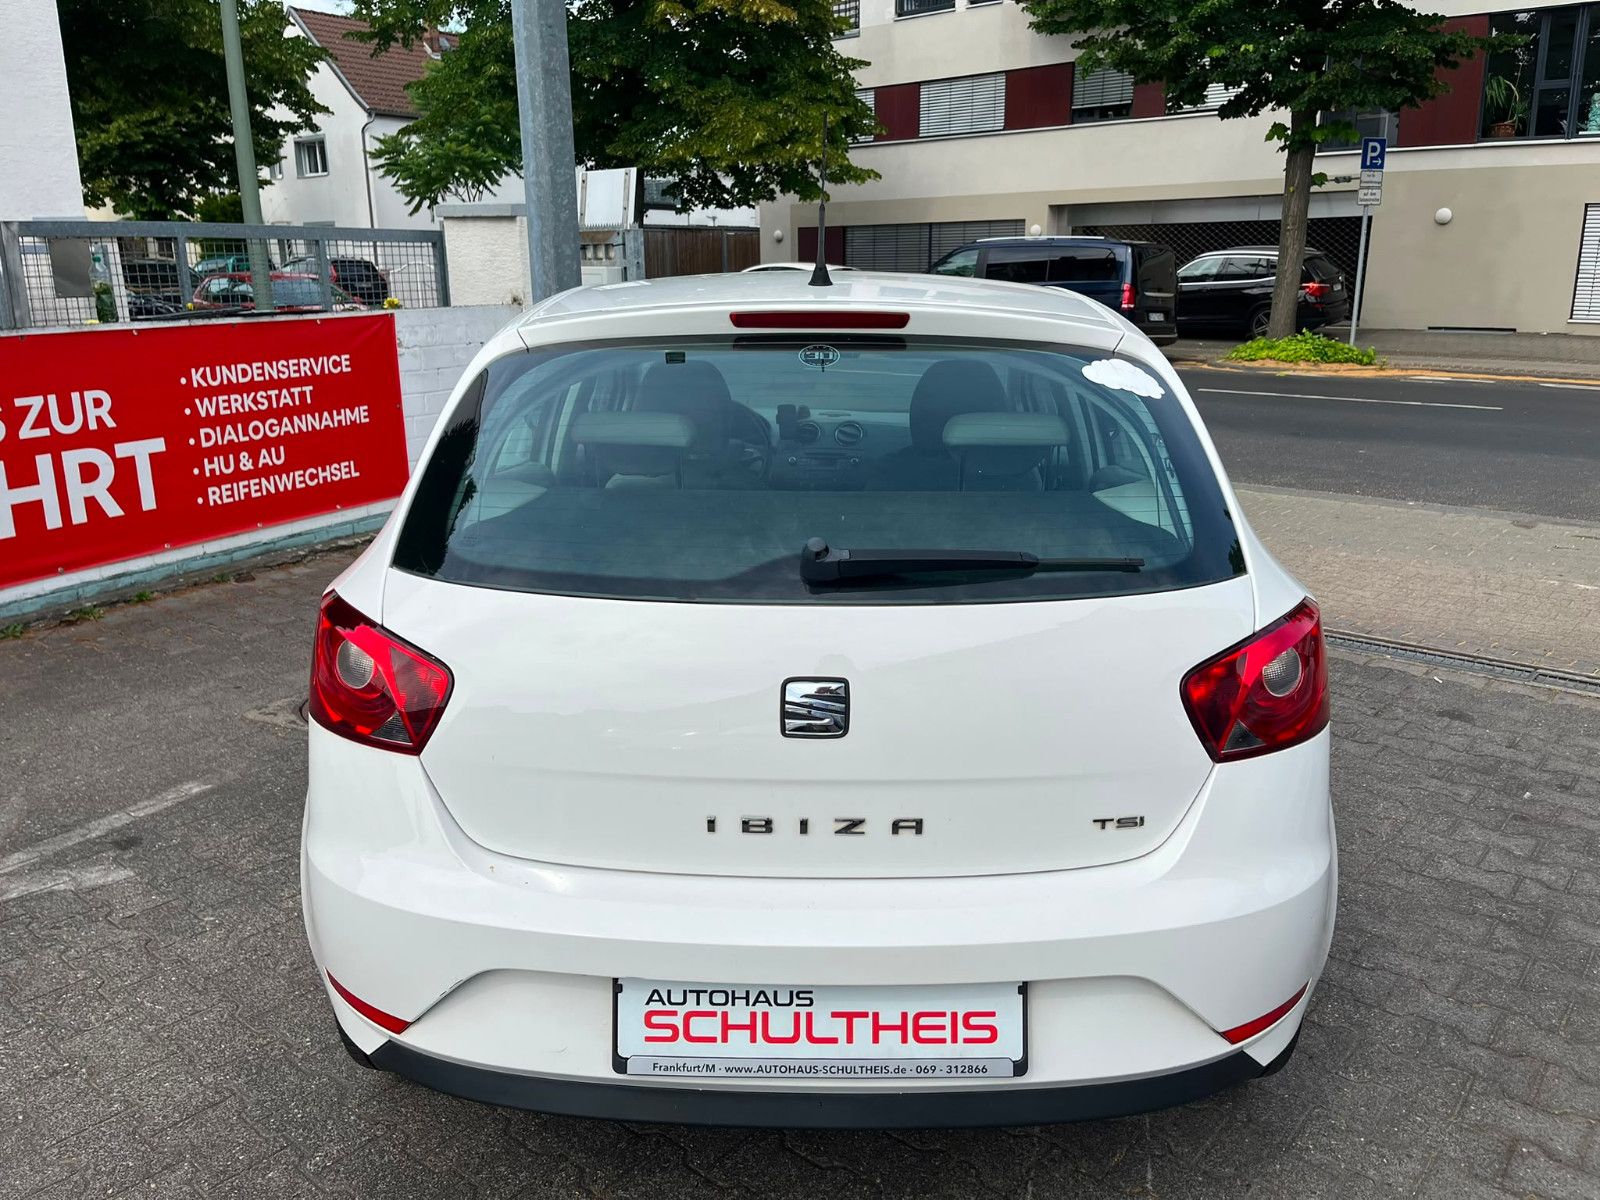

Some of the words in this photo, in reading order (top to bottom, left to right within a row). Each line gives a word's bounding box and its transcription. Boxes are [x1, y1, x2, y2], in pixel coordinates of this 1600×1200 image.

[1366, 141, 1381, 166] P
[190, 354, 352, 388] KUNDENSERVICE
[13, 389, 118, 440] ZUR
[194, 385, 314, 418] WERKSTATT
[199, 405, 370, 448] DIALOGANNAHME
[203, 453, 235, 478] HU
[239, 451, 254, 472] &
[258, 445, 285, 468] AU
[0, 436, 167, 540] HRT
[207, 460, 361, 507] REIFENWECHSEL
[705, 815, 924, 836] IBIZA
[1092, 814, 1146, 830] TSI
[644, 988, 815, 1008] AUTOHAUS
[644, 1009, 999, 1045] SCHULTHEIS
[652, 1062, 716, 1073] Frankfurt/M
[724, 1064, 907, 1075] www.AUTOHAUS-SCHULTHEIS.de
[915, 1064, 937, 1075] 069
[945, 1064, 989, 1075] 312866
